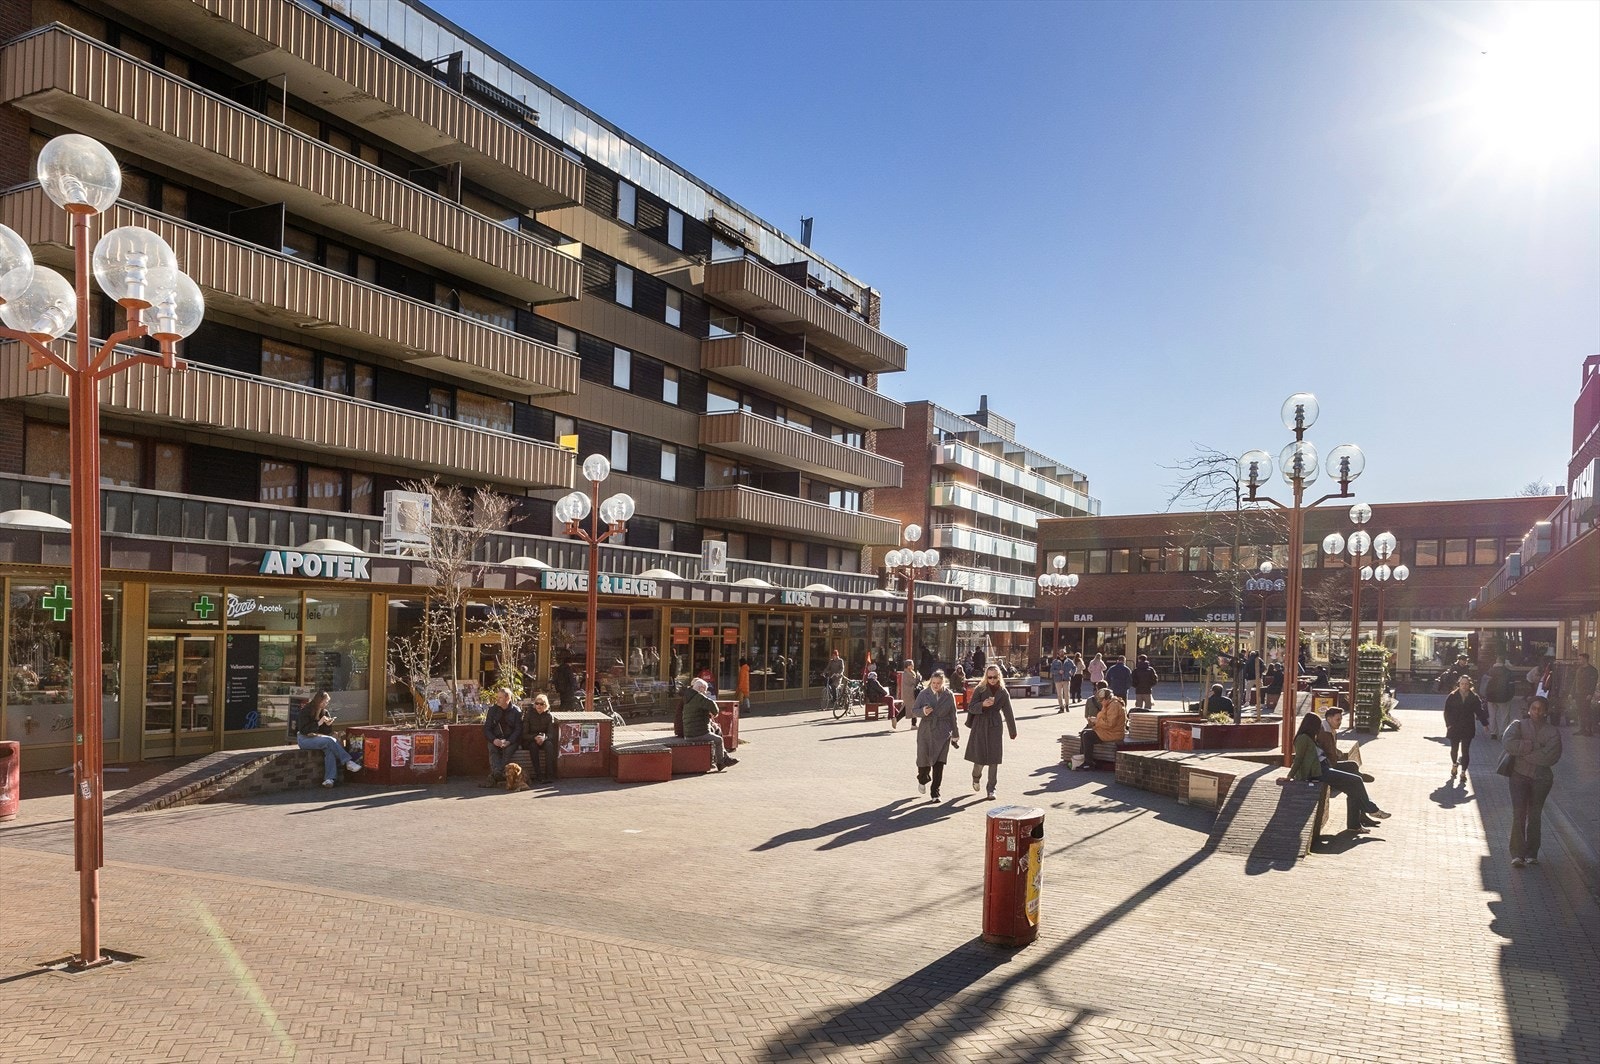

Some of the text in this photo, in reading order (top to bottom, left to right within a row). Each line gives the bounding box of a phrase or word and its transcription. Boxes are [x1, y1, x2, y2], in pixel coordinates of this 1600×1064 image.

[260, 550, 370, 580] APOTEK
[542, 571, 589, 591] BØKE
[613, 577, 657, 597] LEKER
[227, 597, 282, 617] Boots Apotek
[783, 590, 812, 607] KIOSK
[283, 608, 322, 620] Huleie
[1073, 614, 1094, 622] BAR
[1144, 613, 1166, 622] MAT
